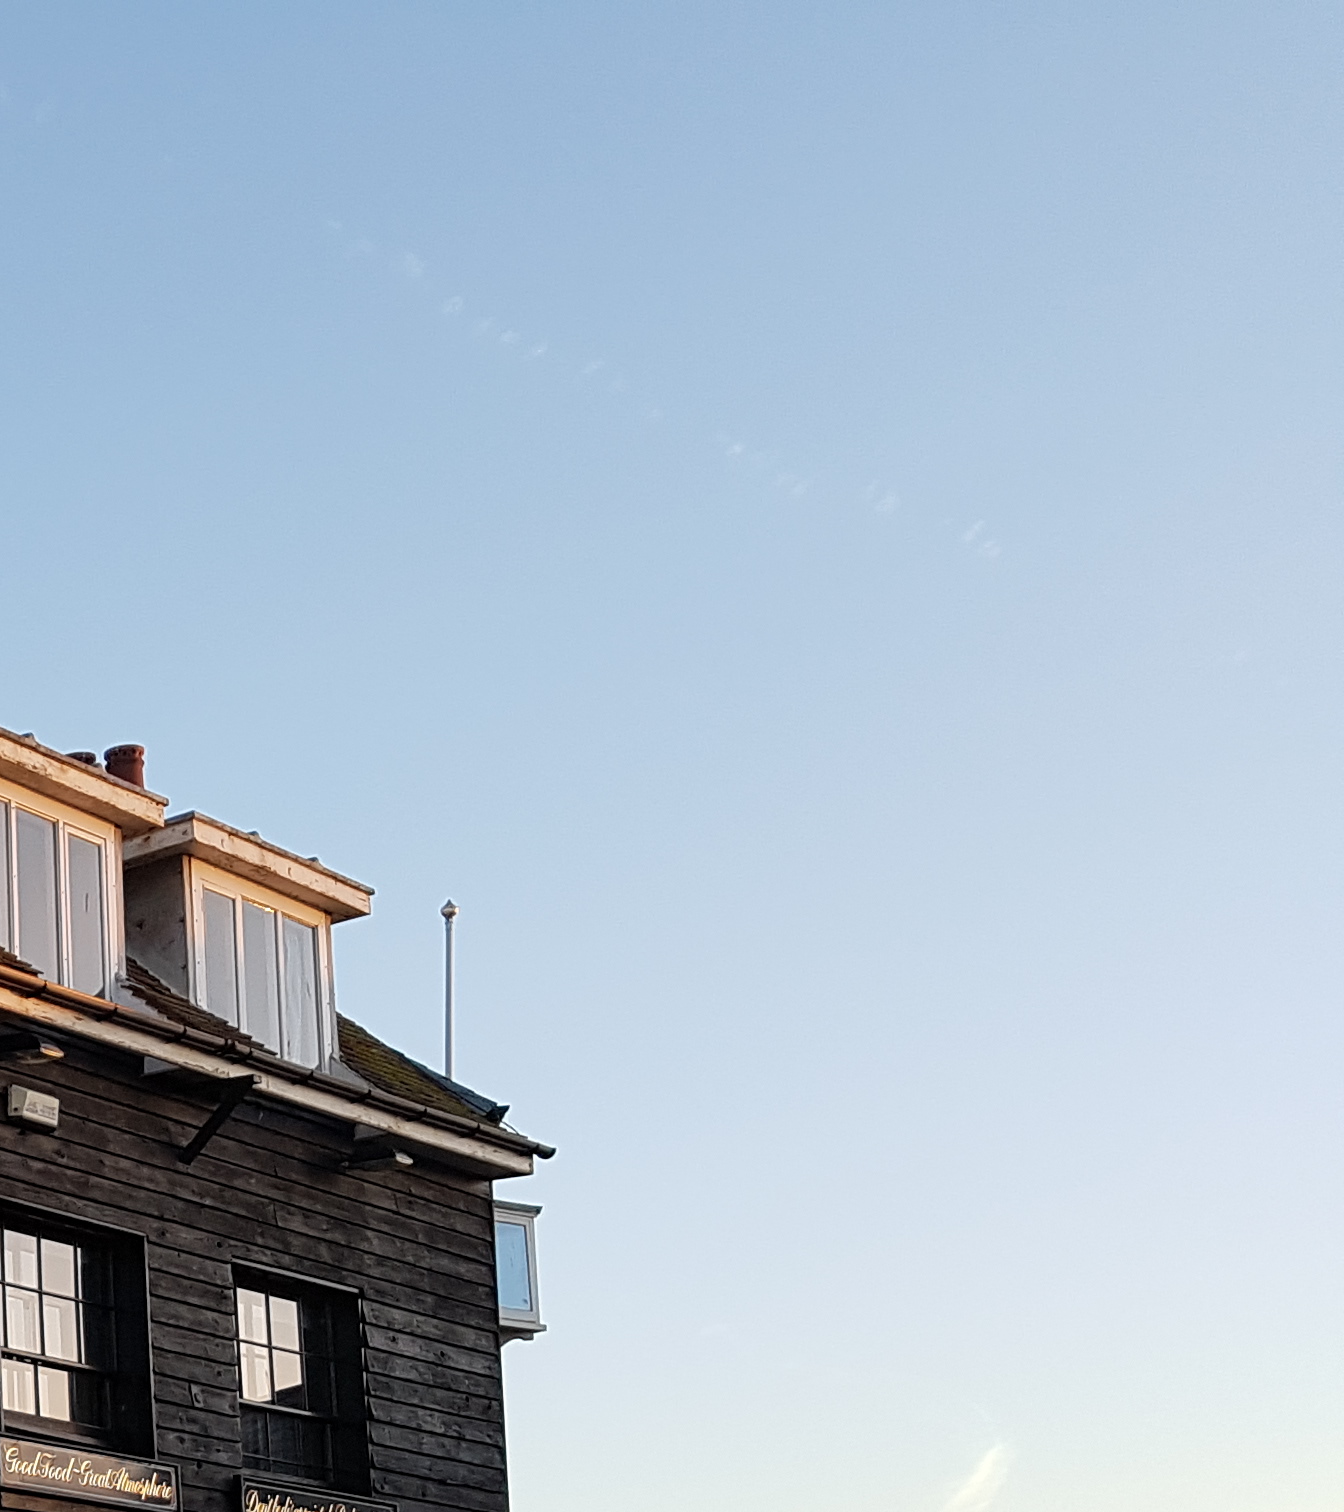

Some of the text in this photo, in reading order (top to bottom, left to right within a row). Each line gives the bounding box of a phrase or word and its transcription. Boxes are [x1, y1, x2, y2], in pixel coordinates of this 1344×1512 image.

[4, 1443, 41, 1474] Good
[37, 1452, 75, 1483] Food
[78, 1457, 113, 1489] Great
[109, 1466, 173, 1500] Atmosphere
